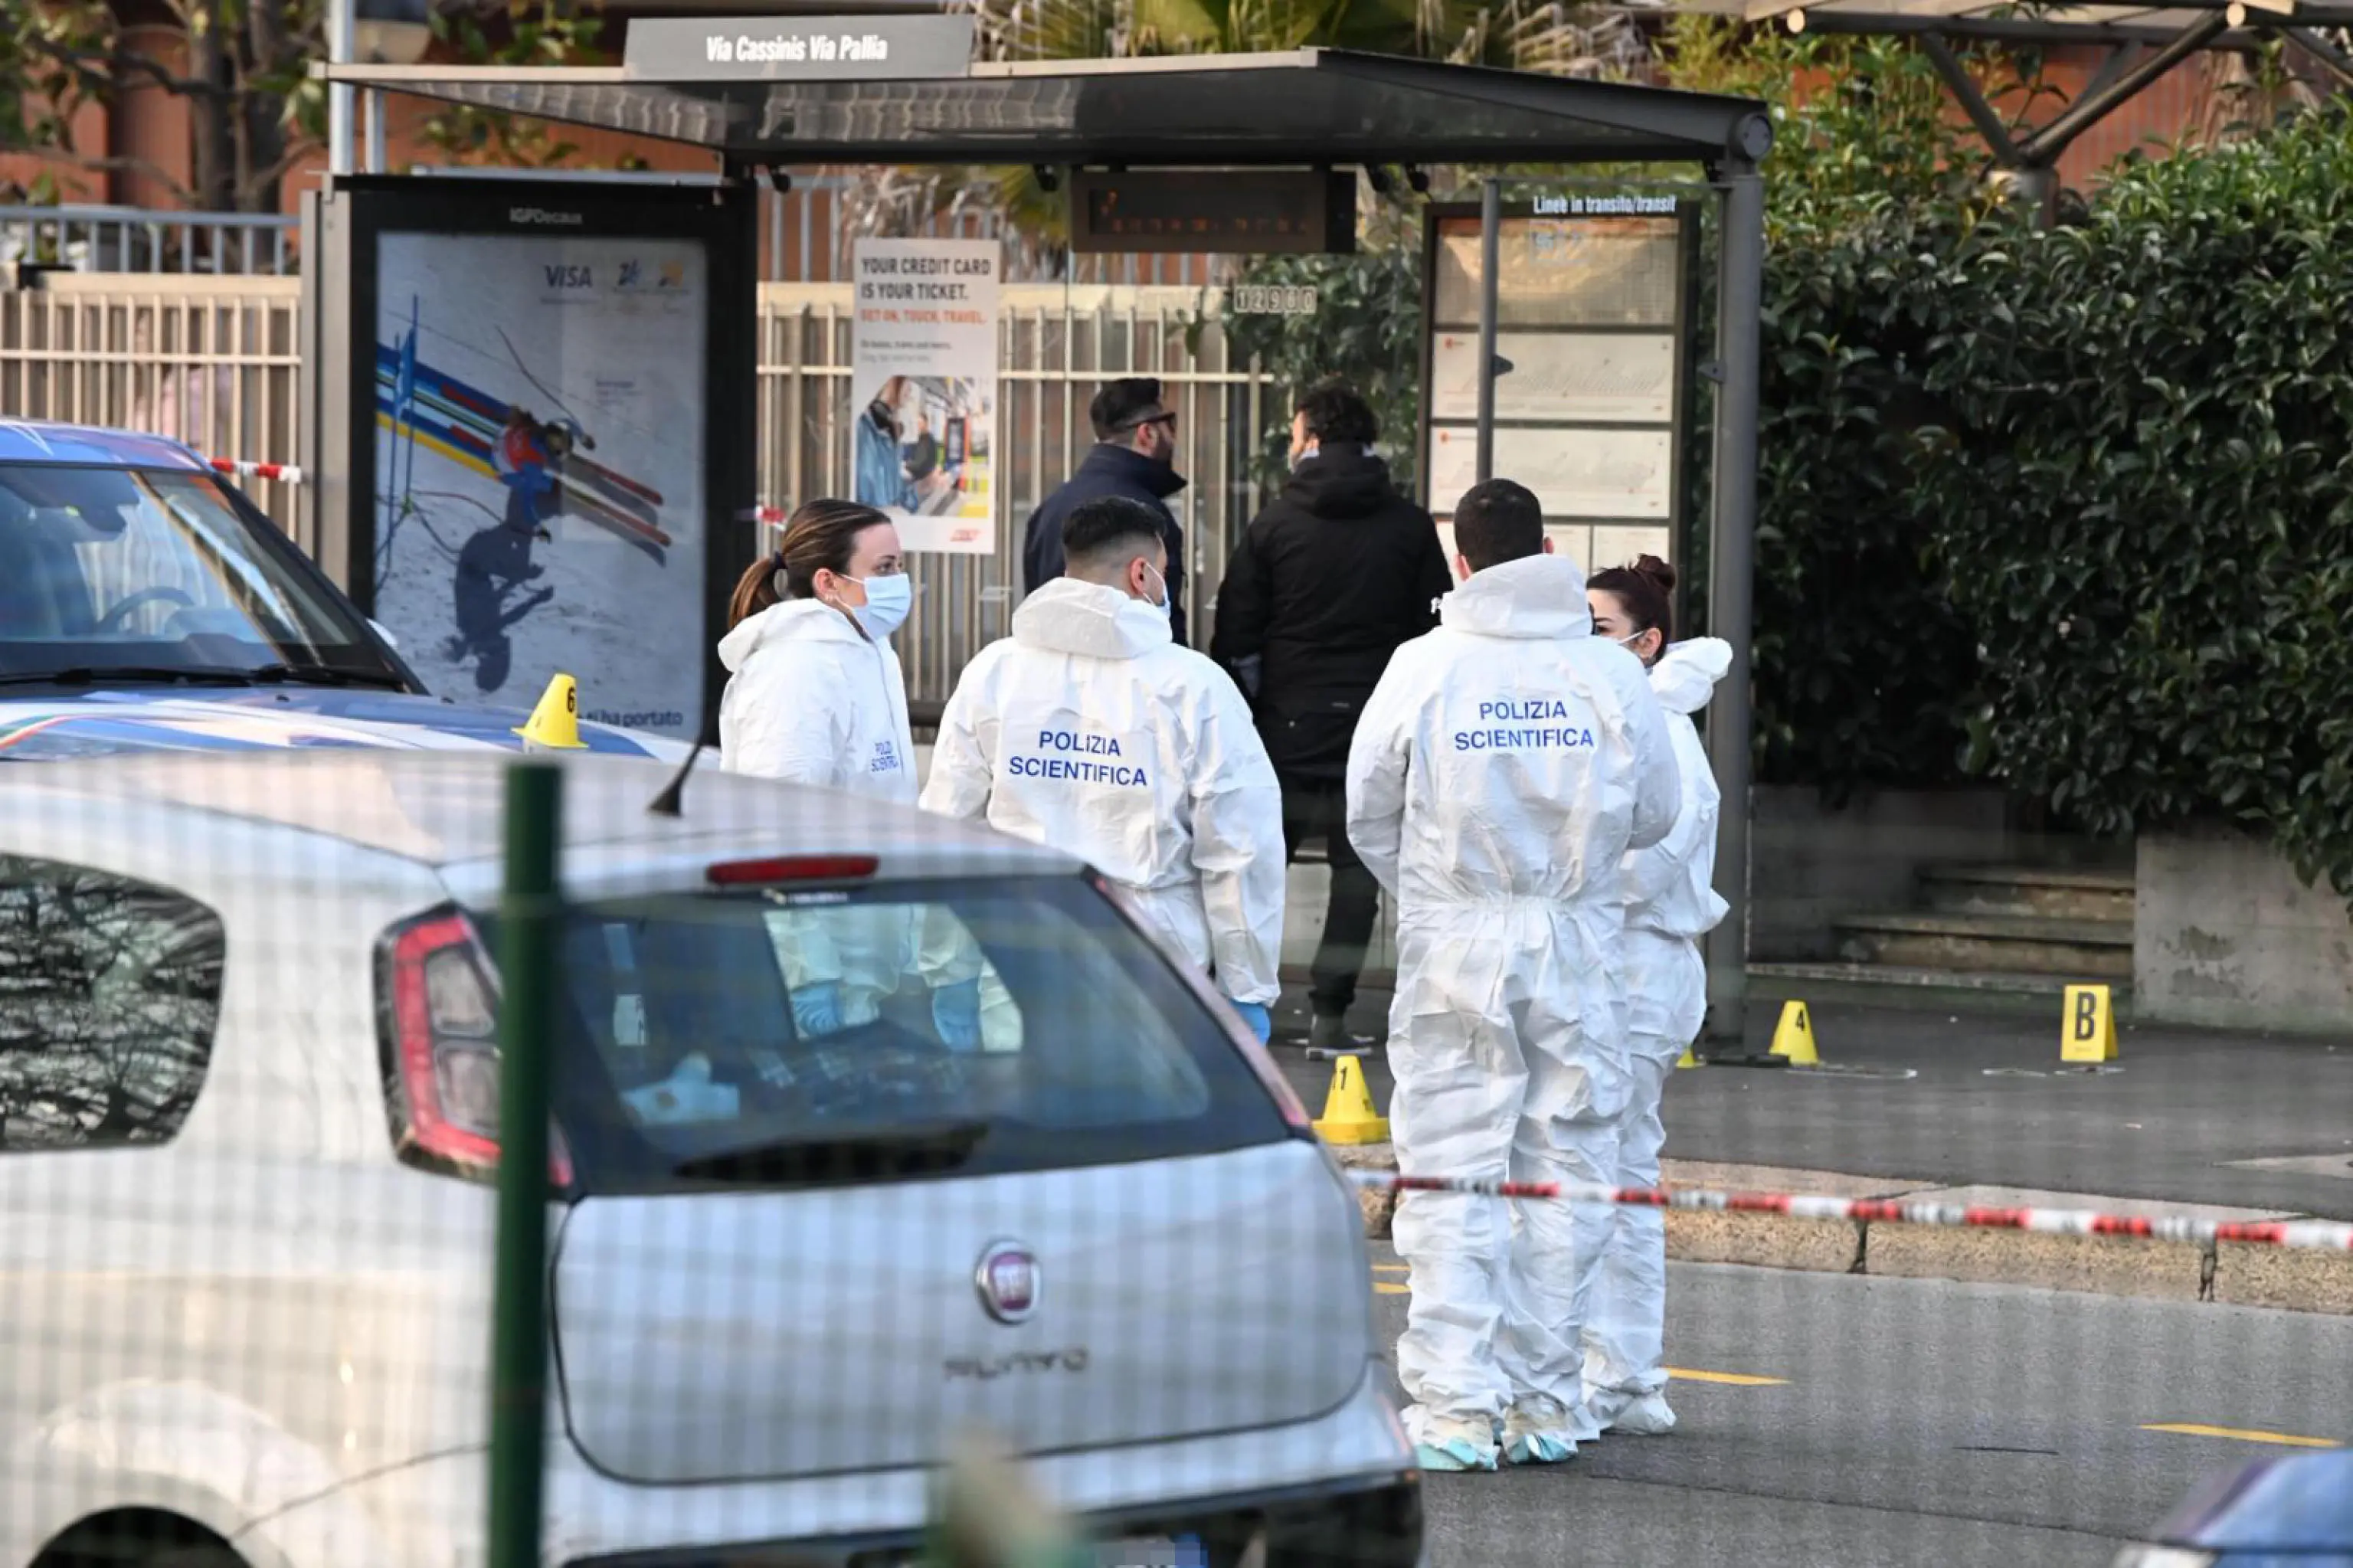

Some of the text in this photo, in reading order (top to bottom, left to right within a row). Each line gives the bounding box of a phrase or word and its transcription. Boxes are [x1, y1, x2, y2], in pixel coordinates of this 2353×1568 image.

[705, 35, 733, 61] Via
[736, 34, 807, 61] Cassinis
[810, 34, 836, 61] Via
[1571, 195, 1584, 213] in
[545, 265, 593, 288] VISA
[862, 257, 991, 275] YOUR CREDIT CARD
[861, 283, 970, 300] IS YOUR TICKET.
[566, 686, 575, 713] 6
[1479, 700, 1568, 721] POLIZIA
[623, 711, 683, 727] portato
[1039, 730, 1121, 757] POLIZIA
[1455, 728, 1594, 751] SCIENTIFICA
[1009, 755, 1147, 786] SCIENTIFICA
[1795, 1009, 1806, 1032] 4
[2074, 990, 2096, 1041] B
